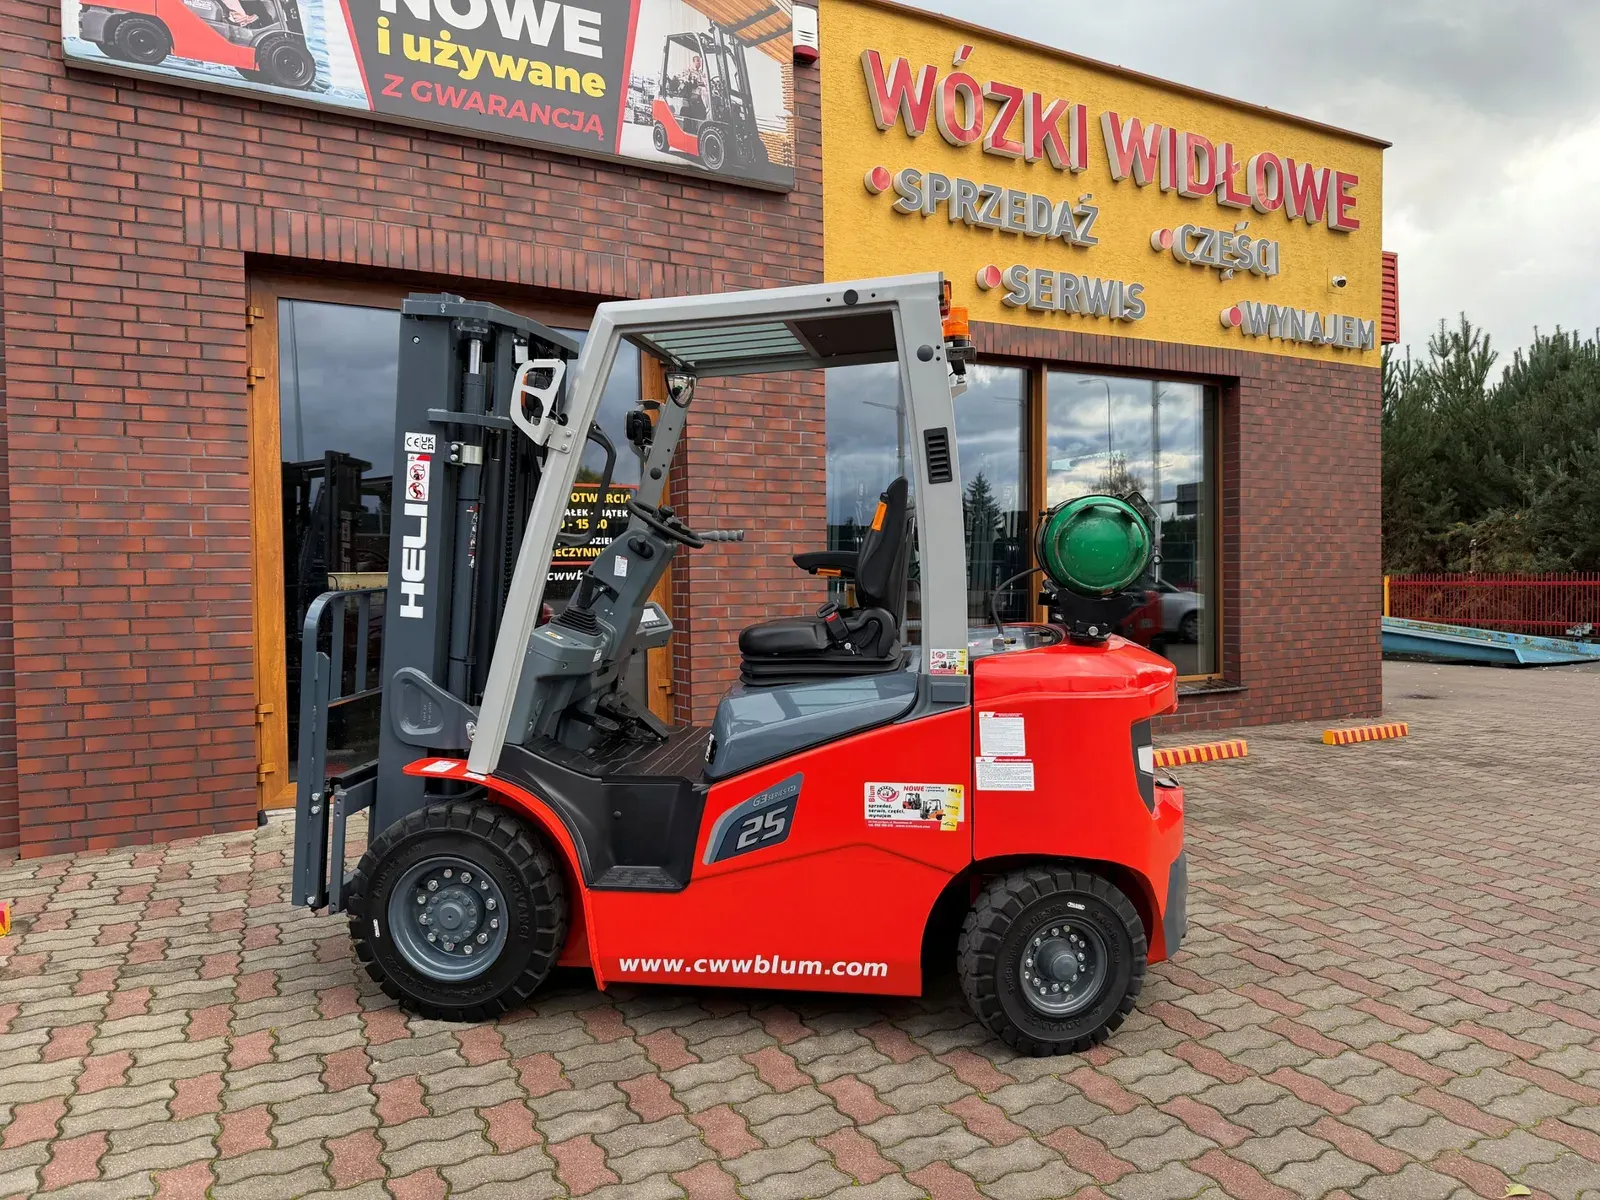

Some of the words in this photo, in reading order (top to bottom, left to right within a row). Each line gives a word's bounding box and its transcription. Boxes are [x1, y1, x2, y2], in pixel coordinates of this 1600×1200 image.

[377, 16, 390, 56] i
[402, 29, 607, 98] używane
[381, 73, 405, 98] Z
[410, 80, 605, 141] GWARANCJĄ
[861, 44, 1088, 174] WÓZKI
[1100, 110, 1360, 233] WIDŁOWE
[893, 167, 1099, 248] SPRZEDAŻ
[1171, 221, 1280, 280] CZĘŚCI
[1001, 265, 1148, 322] SERWIS
[1239, 300, 1375, 352] WYNAJEM
[564, 508, 588, 517] AŁEK
[602, 509, 628, 519] IĄTEK
[571, 493, 631, 504] OTWRCIA
[400, 503, 428, 619] HELI
[735, 805, 789, 851] 25
[618, 954, 889, 977] www.cwwblum.com
